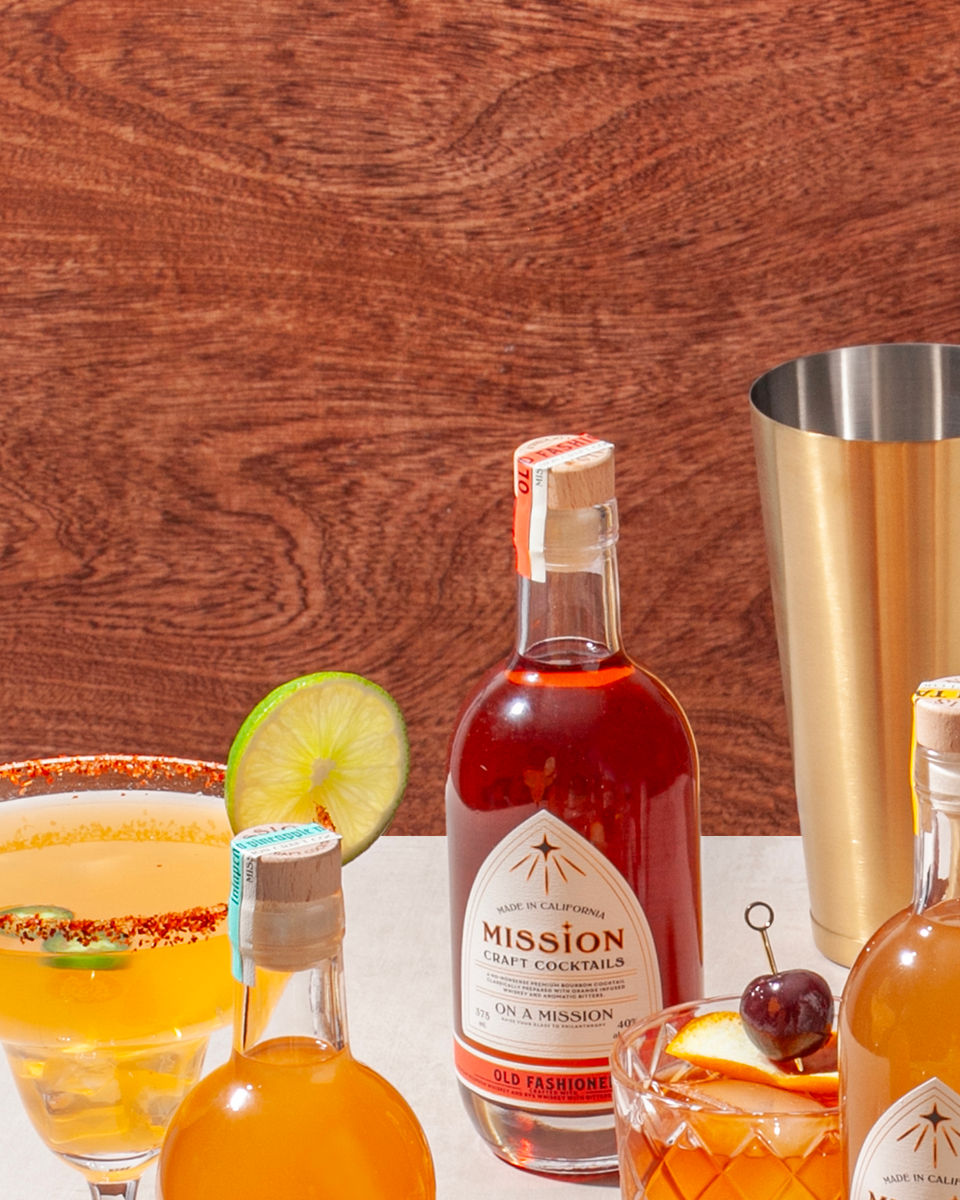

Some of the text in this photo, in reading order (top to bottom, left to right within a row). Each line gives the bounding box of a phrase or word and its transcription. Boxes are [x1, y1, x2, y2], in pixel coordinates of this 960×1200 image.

[497, 902, 524, 914] MADE
[540, 902, 605, 919] CALIFORNIA
[482, 920, 624, 954] MISSION
[483, 950, 625, 971] CRAFT COCKTAILS
[495, 1002, 613, 1022] ON A MISSION
[493, 1069, 520, 1085] OLD
[883, 1174, 910, 1184] MADE
